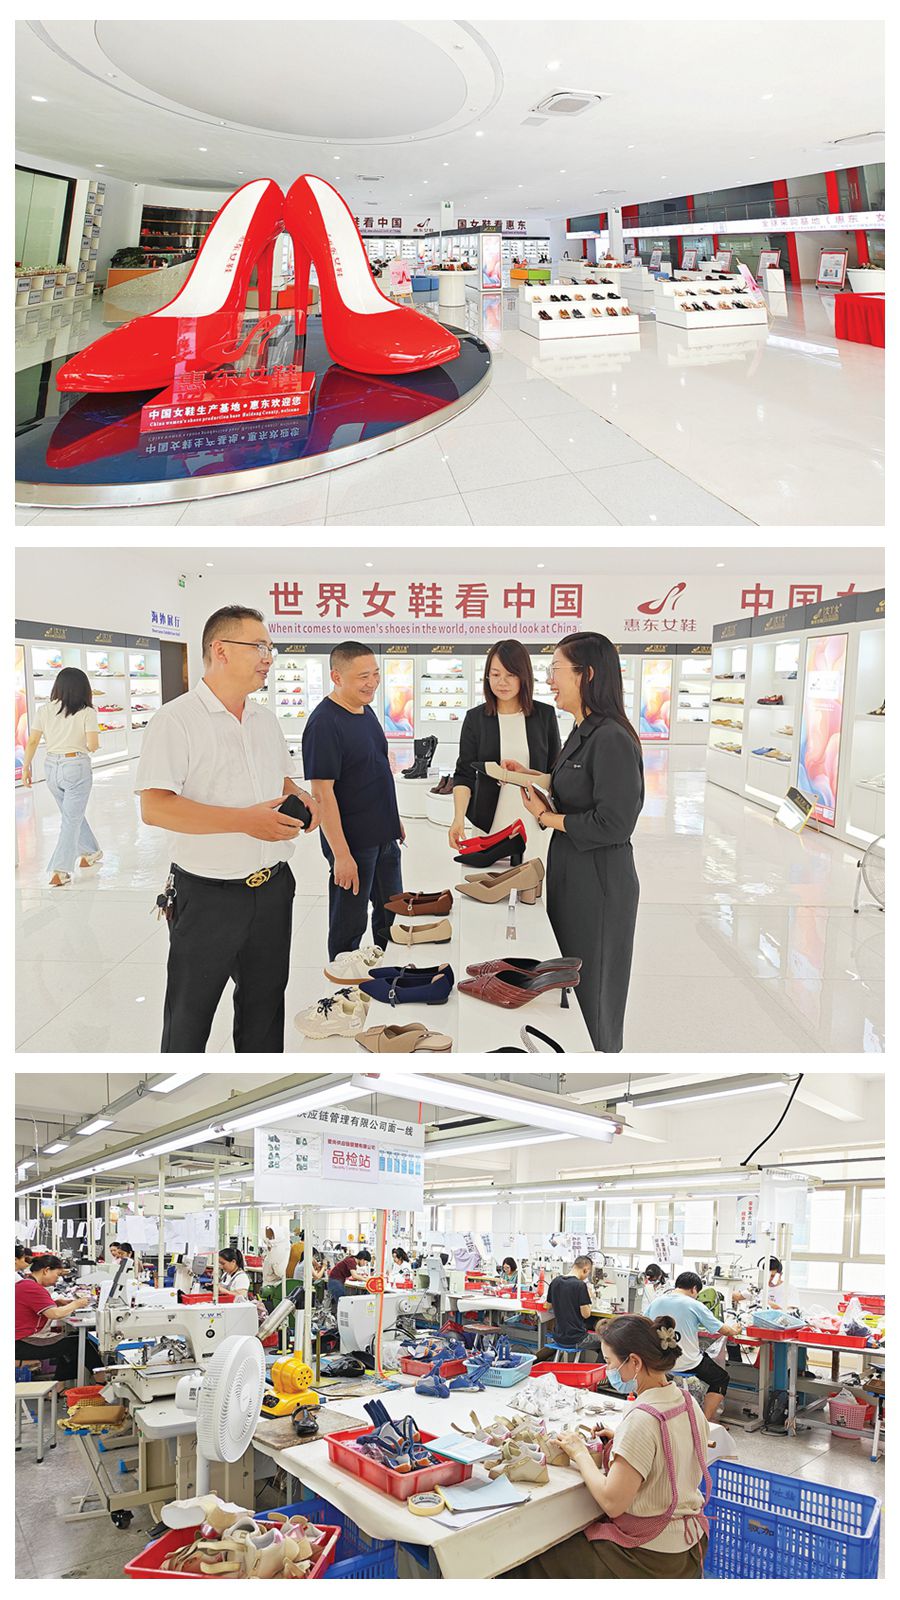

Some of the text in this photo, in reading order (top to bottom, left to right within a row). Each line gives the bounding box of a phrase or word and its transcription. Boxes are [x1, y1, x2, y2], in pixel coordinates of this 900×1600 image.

[269, 582, 583, 619] 世界女鞋看中国
[268, 623, 293, 633] When
[294, 623, 301, 633] it
[303, 625, 331, 633] comes
[332, 624, 341, 633] to
[343, 624, 383, 633] women's
[385, 623, 410, 633] shoes
[411, 623, 420, 633] in
[422, 623, 437, 633] the
[438, 623, 468, 635] world,
[469, 625, 485, 633] one
[487, 623, 517, 633] should
[519, 623, 539, 633] look
[540, 624, 550, 633] at
[624, 618, 697, 632] 惠东女鞋
[332, 1150, 371, 1168] 品检站
